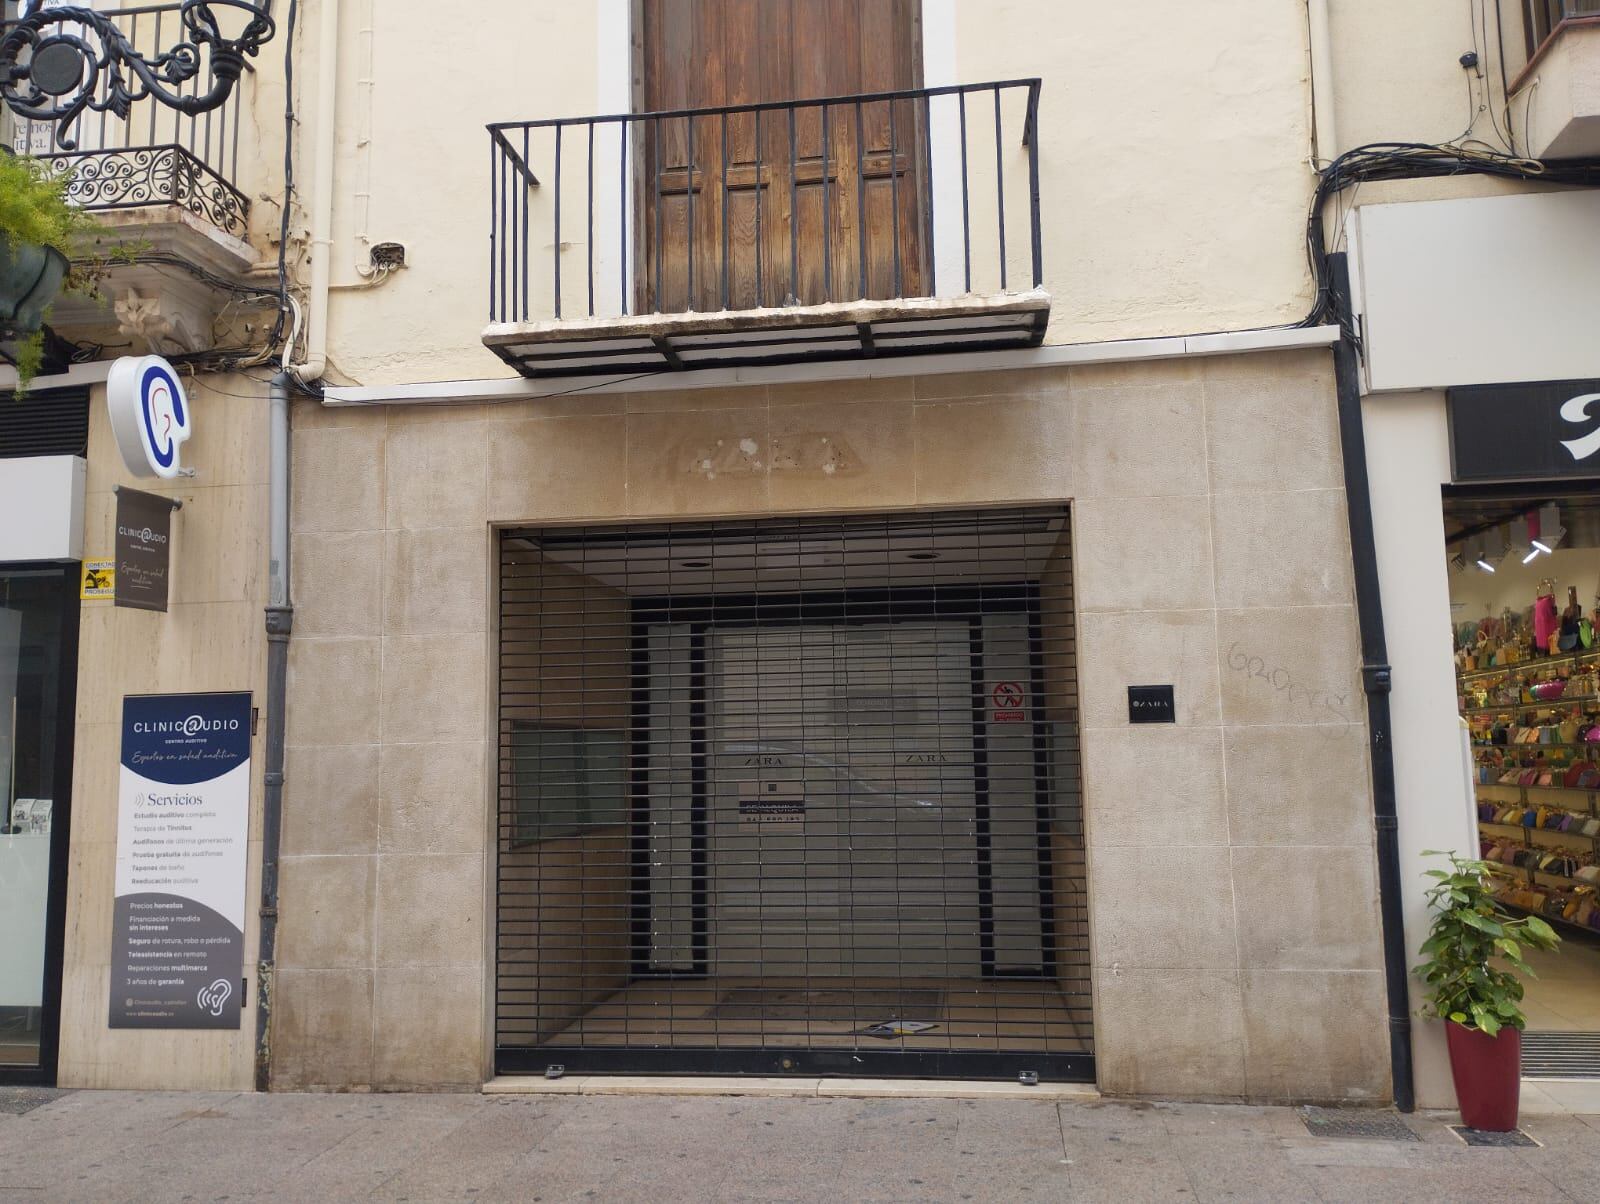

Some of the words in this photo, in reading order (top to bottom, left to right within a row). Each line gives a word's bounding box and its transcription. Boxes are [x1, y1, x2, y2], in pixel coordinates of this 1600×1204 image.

[133, 715, 239, 736] CLINIC@UDIO
[906, 754, 947, 763] ZARA
[147, 793, 203, 806] Servicios
[159, 811, 184, 819] auditivo
[129, 915, 169, 923] Financiación
[205, 937, 231, 945] pérdida
[127, 964, 170, 972] Reparaciones
[171, 964, 208, 972] multimarca
[157, 978, 184, 987] garantía
